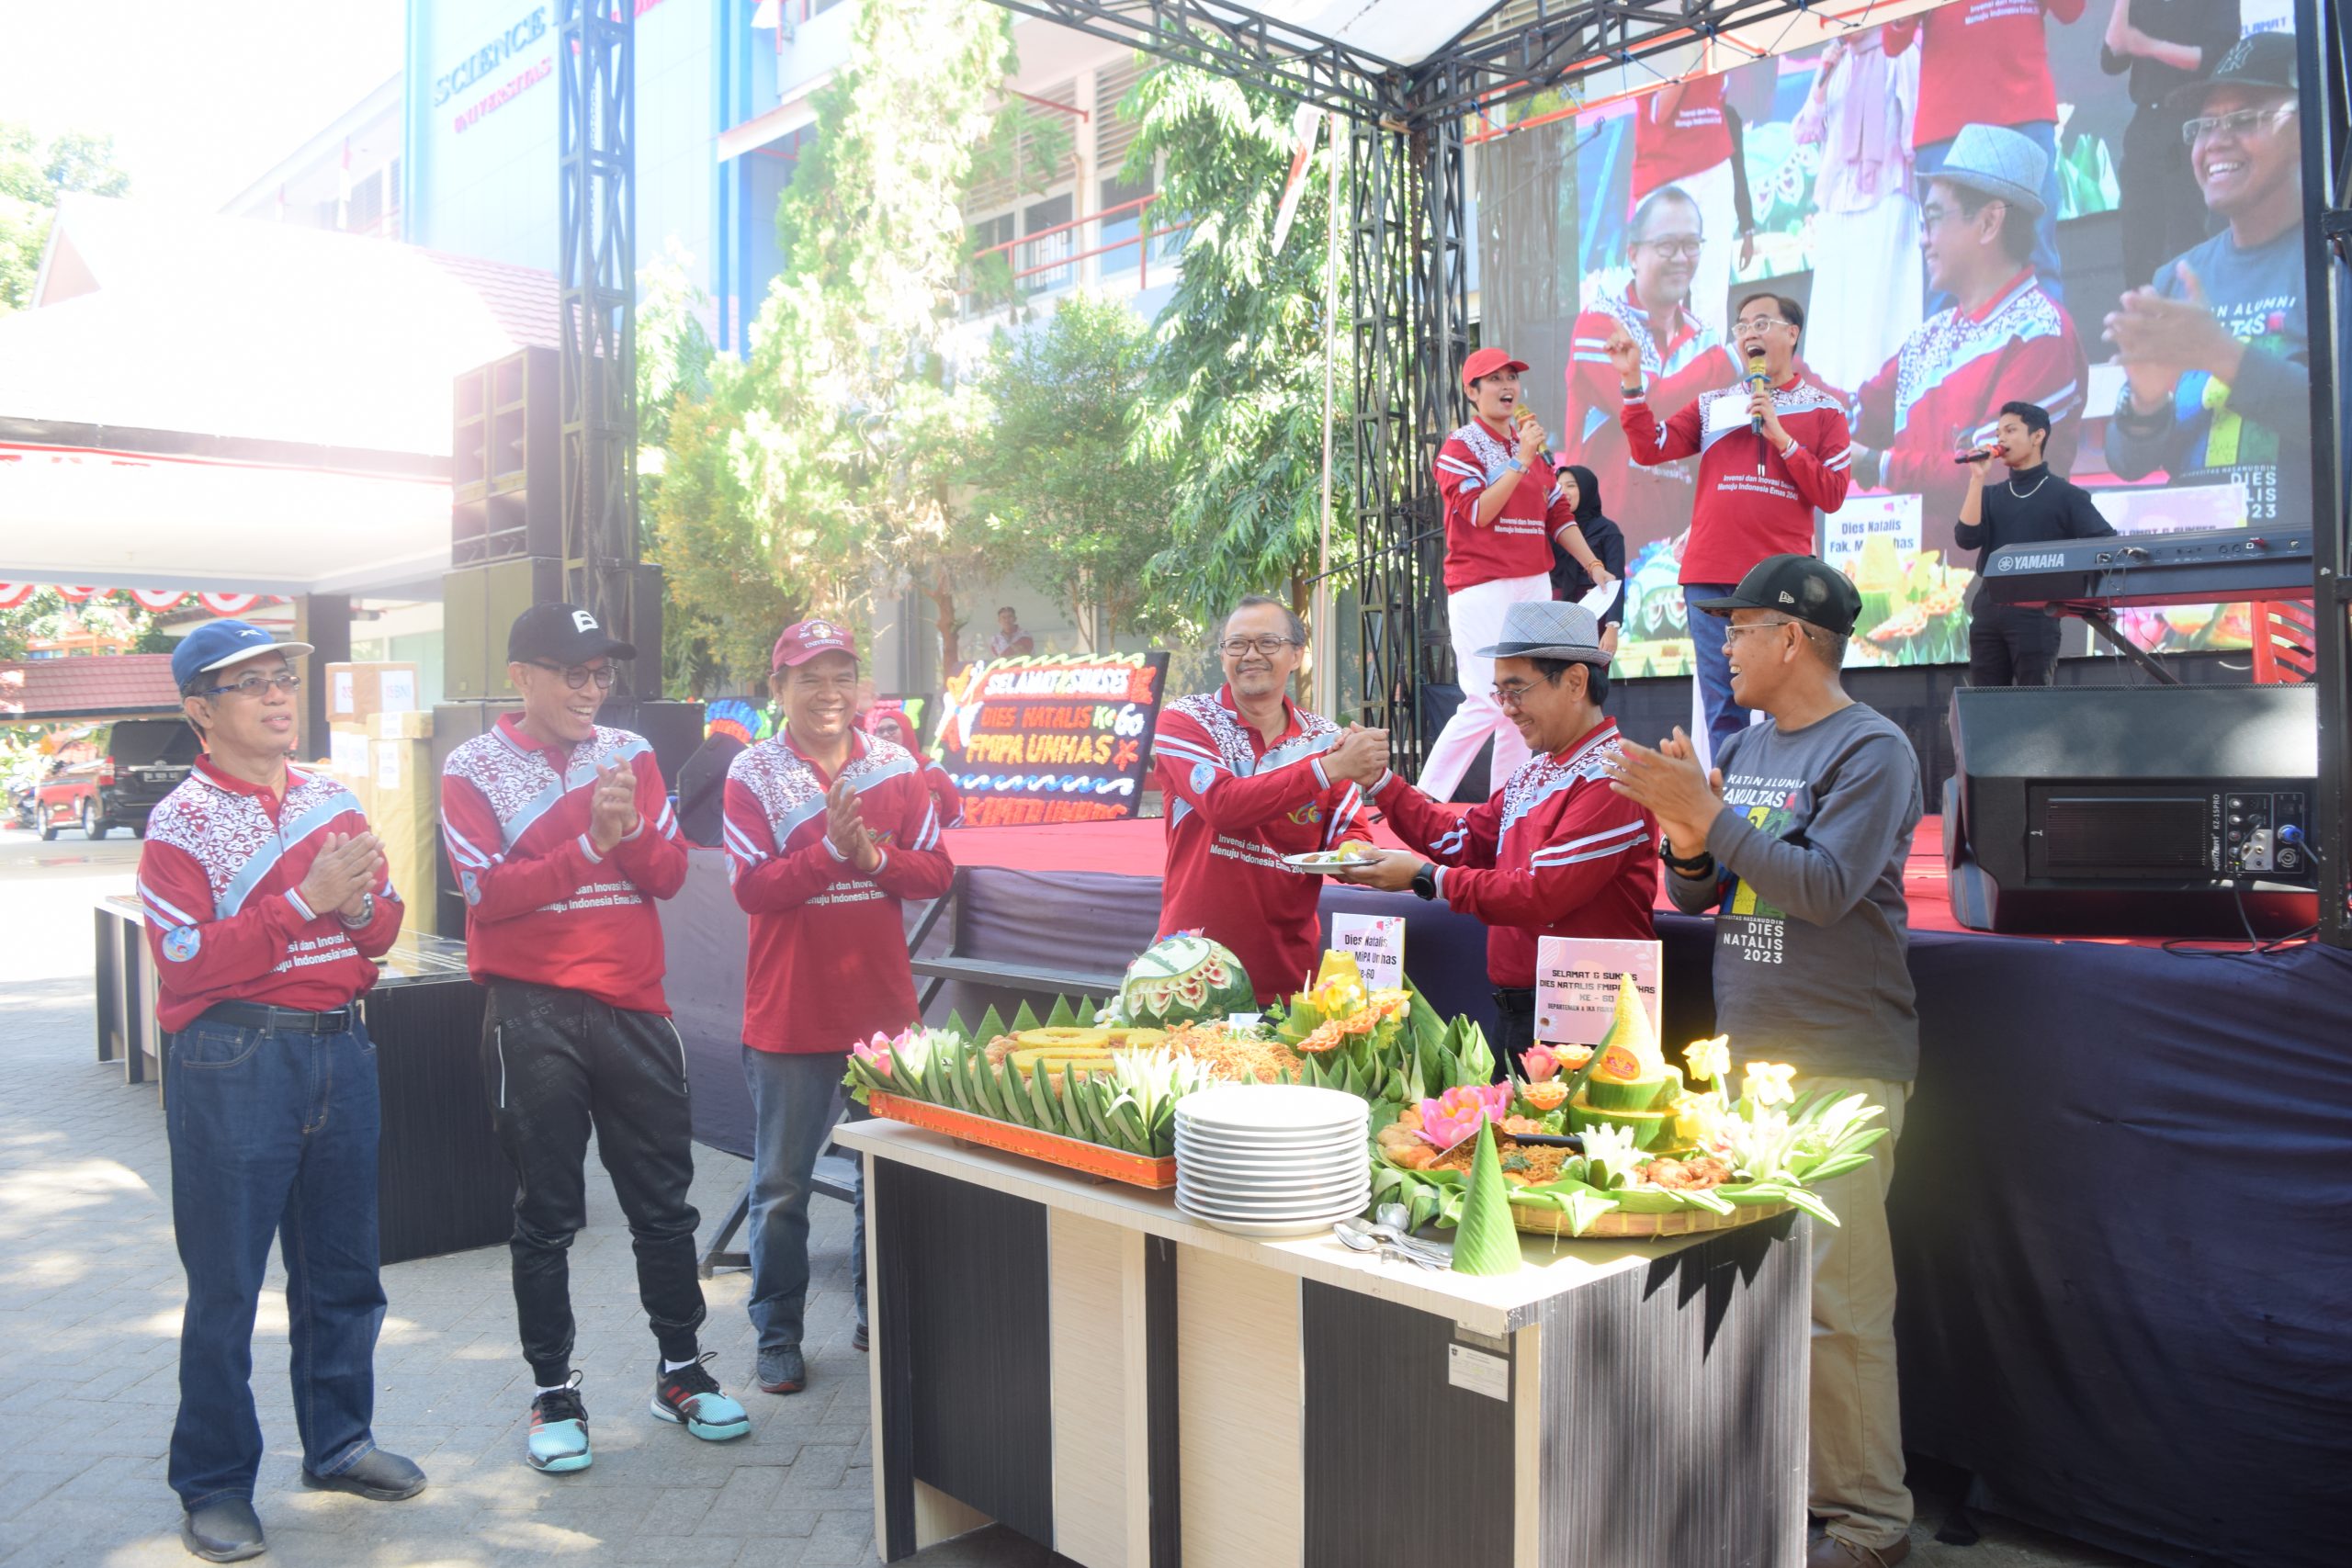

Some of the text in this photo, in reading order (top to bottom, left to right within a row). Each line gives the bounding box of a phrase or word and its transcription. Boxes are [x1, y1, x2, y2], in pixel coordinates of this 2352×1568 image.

[435, 6, 547, 108] SCIENCE
[2233, 295, 2296, 316] ALUMNI
[2231, 471, 2277, 486] DIES
[1738, 482, 1769, 493] Indonesia
[1894, 537, 1914, 549] has
[2015, 553, 2064, 570] YAMAHA
[980, 705, 1017, 728] DIES
[1022, 705, 1093, 729] NATALIS
[1026, 734, 1114, 765] UNHAS
[1727, 773, 1763, 786] KATAN
[1218, 833, 1245, 849] Invensi
[1246, 840, 1260, 852] dan
[1210, 844, 1239, 860] Menuju
[1240, 851, 1275, 868] Indonesia
[1291, 864, 1305, 874] 204
[594, 881, 621, 892] Inovasi
[837, 882, 851, 891] dan
[569, 896, 613, 909] Indonesia
[806, 894, 830, 907] enuju
[831, 891, 870, 904] Indonesia
[1743, 916, 1784, 926] HASANUDDIN
[1748, 921, 1784, 937] DIES
[1344, 934, 1388, 948] Dies Natalis
[1724, 932, 1783, 951] NATALIS
[294, 949, 341, 967] Indonesia
[340, 946, 358, 957] mas
[1744, 948, 1783, 964] 2023
[1360, 968, 1374, 979] e-60
[1552, 969, 1589, 979] SELAMAT
[1540, 979, 1555, 987] DIES
[1557, 981, 1594, 990] NATALIS
[1636, 986, 1656, 995] HAS
[1579, 994, 1591, 1002] KE
